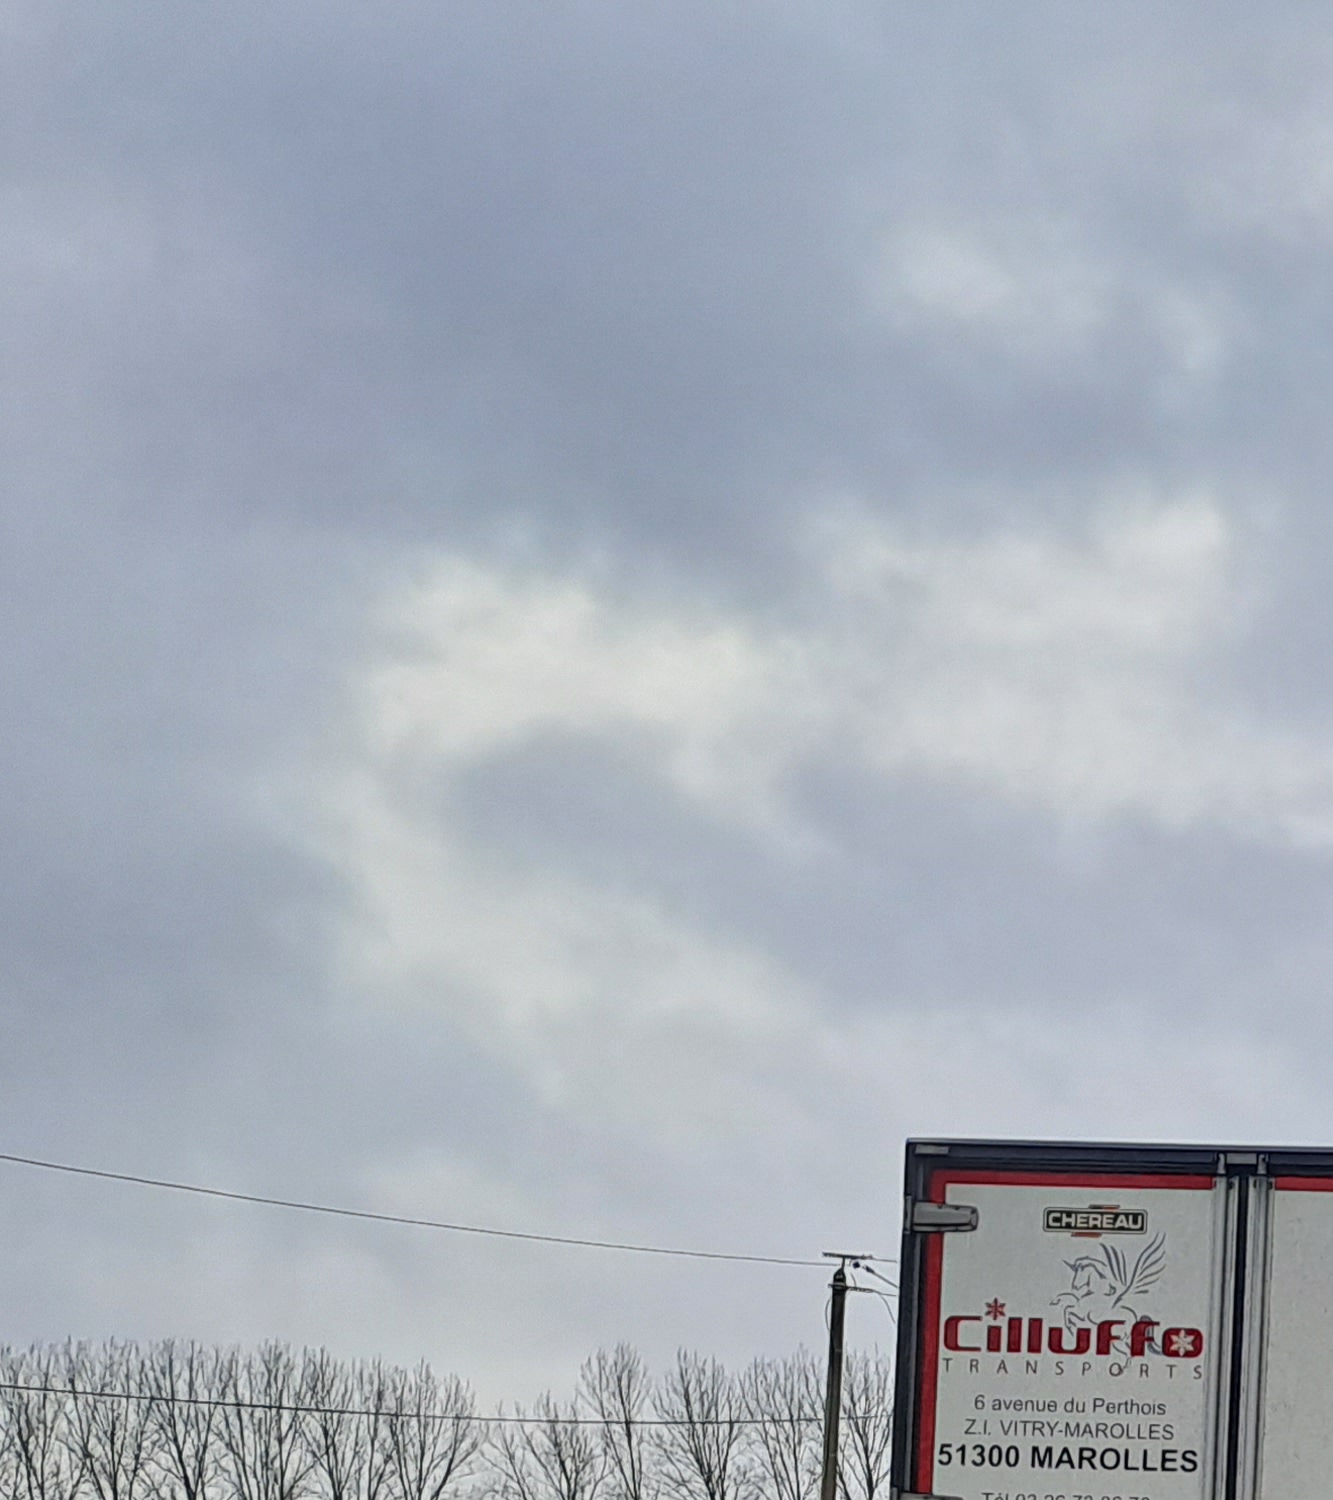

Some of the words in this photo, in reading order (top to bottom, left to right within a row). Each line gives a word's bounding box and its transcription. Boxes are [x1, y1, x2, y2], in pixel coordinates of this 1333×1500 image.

[1047, 1211, 1144, 1231] CHEREAU
[942, 1358, 1203, 1380] TRANSPORTS
[973, 1394, 986, 1411] 6
[991, 1399, 1058, 1413] avenue
[1063, 1397, 1086, 1414] du
[1092, 1398, 1167, 1416] Perthois
[964, 1418, 992, 1436] Z.I.
[999, 1420, 1175, 1440] VITRY-MAROLLES
[937, 1443, 1020, 1467] 51300
[1030, 1446, 1198, 1472] MAROLLES
